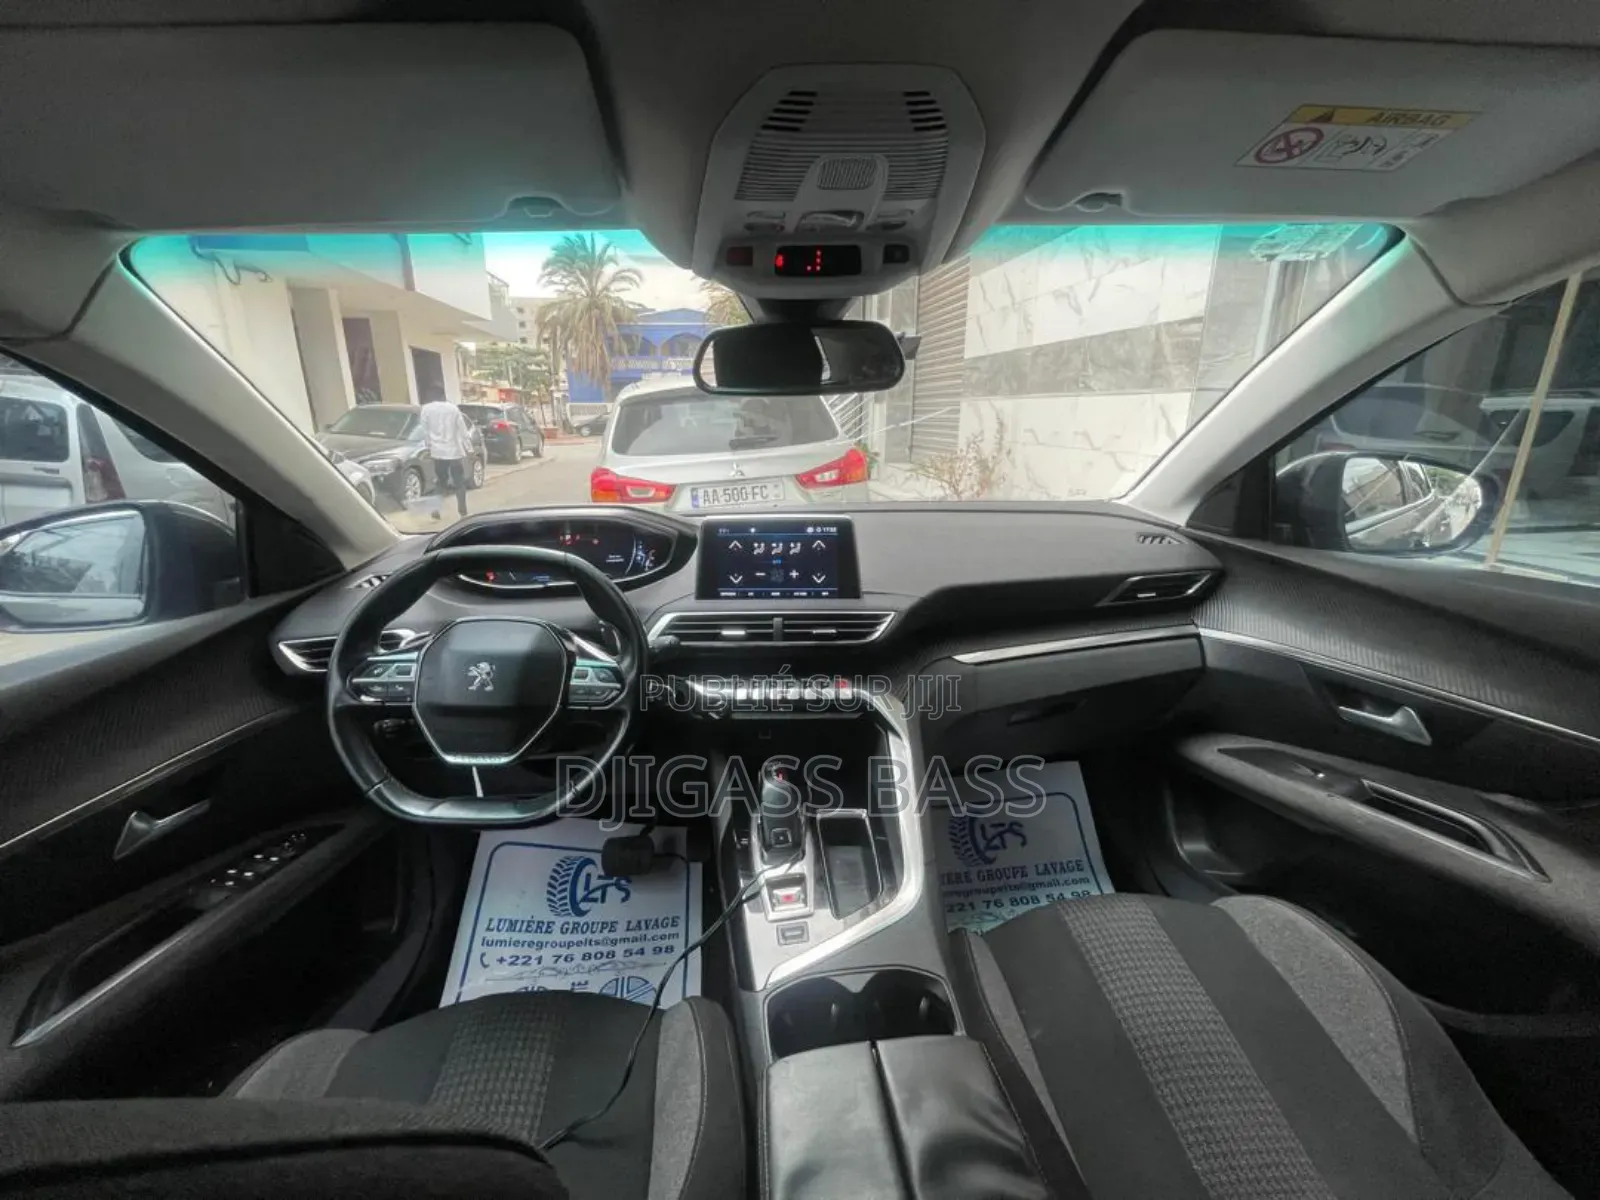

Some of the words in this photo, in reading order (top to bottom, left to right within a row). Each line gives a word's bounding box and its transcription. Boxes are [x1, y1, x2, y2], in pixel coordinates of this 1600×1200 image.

[1365, 111, 1451, 126] AIRBAG
[1034, 859, 1085, 876] LAVAGE
[982, 898, 1005, 910] 76
[1009, 894, 1041, 907] 808
[559, 919, 619, 935] GROUPE
[626, 915, 681, 932] LAVAGE
[480, 932, 680, 951] lumieregroupelts@gmail.com
[496, 954, 543, 967] +221
[552, 953, 574, 964] 76
[581, 950, 616, 963] 808
[623, 947, 645, 958] 54
[651, 944, 675, 955] 98
